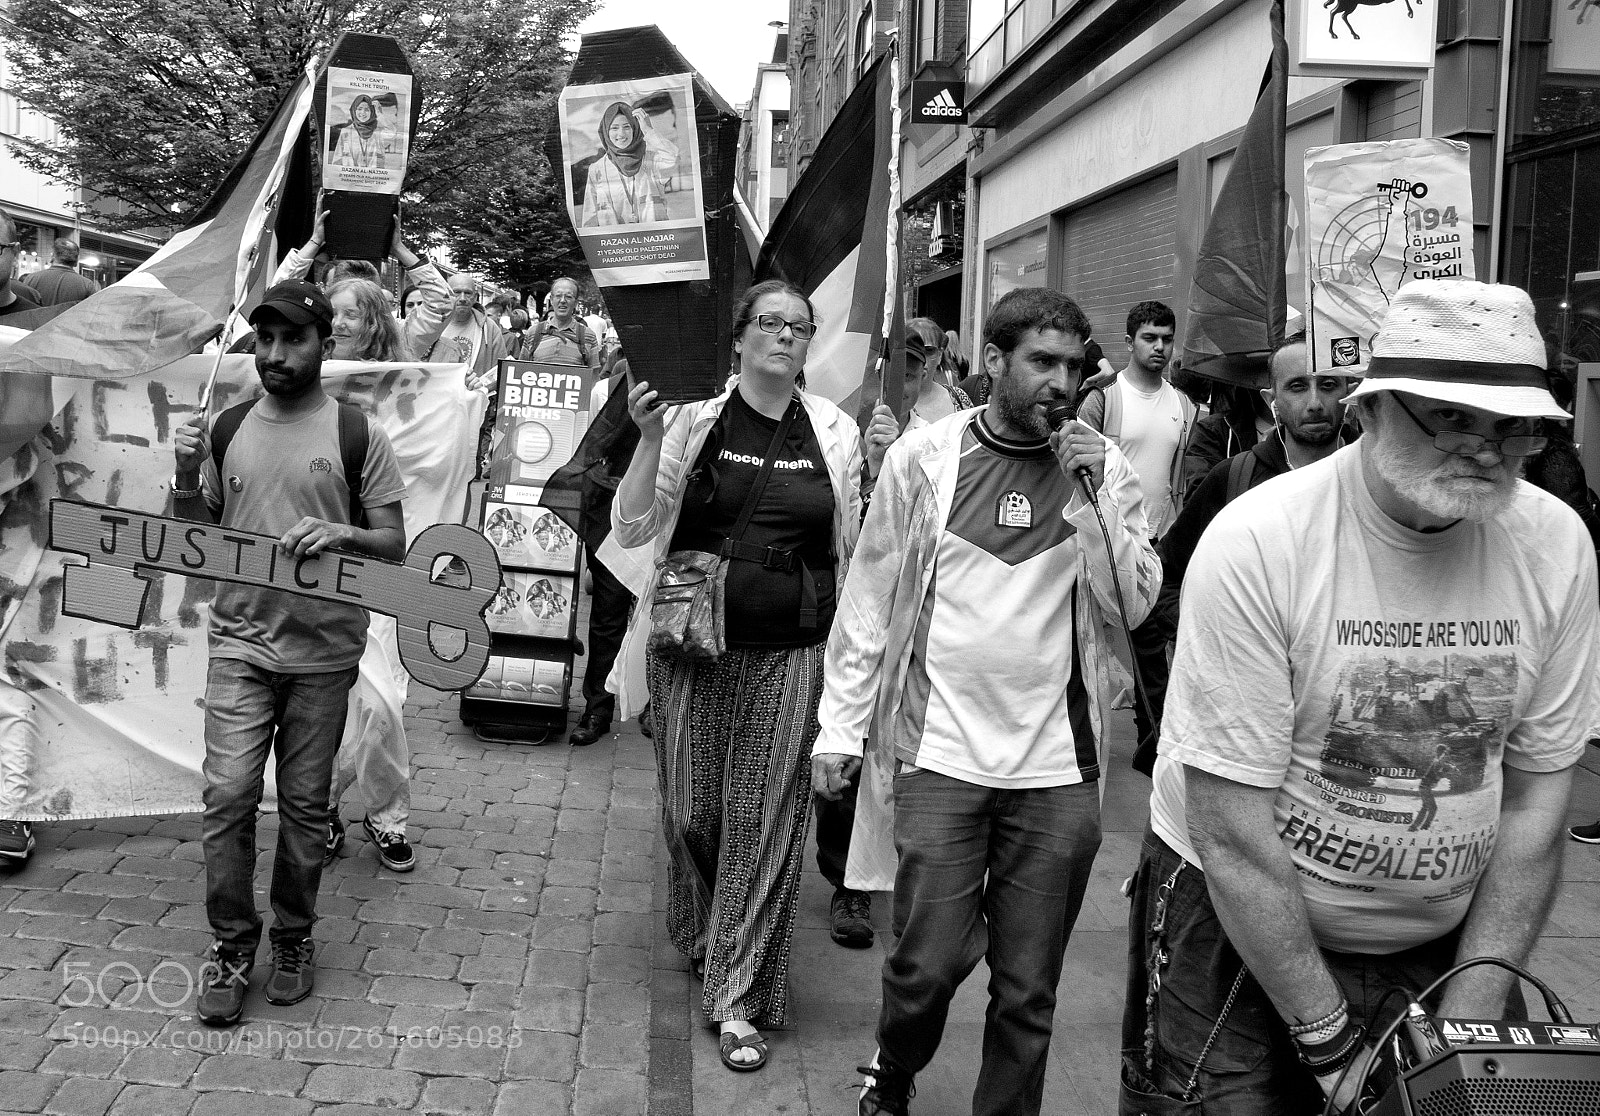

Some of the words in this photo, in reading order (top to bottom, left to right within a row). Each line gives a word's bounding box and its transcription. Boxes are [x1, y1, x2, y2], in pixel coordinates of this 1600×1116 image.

[921, 105, 963, 117] adidas
[1410, 206, 1459, 232] 194
[600, 238, 629, 247] RAZAN
[630, 236, 642, 244] AL
[643, 234, 675, 244] NAJJAR
[604, 248, 625, 256] YEARS
[640, 244, 680, 253] PALESTINIAN
[1413, 234, 1460, 250] مسيرة
[602, 256, 640, 264] PARAMEDIC
[1414, 246, 1462, 265] العودة
[506, 366, 582, 390] Learn
[504, 385, 580, 410] BIBLE
[502, 405, 561, 420] TRUTHS
[100, 514, 365, 598] JUSTICE
[1336, 620, 1391, 648] WHOSE
[1390, 622, 1423, 648] SIDE
[1426, 622, 1457, 648] ARE
[1460, 620, 1490, 646] YOU
[1494, 619, 1521, 646] ON?
[1304, 770, 1386, 804] MARTYRED
[1290, 803, 1322, 826] THE
[1320, 790, 1338, 804] by
[1334, 801, 1414, 824] ZIONISTS
[1442, 1019, 1499, 1037] ALTO
